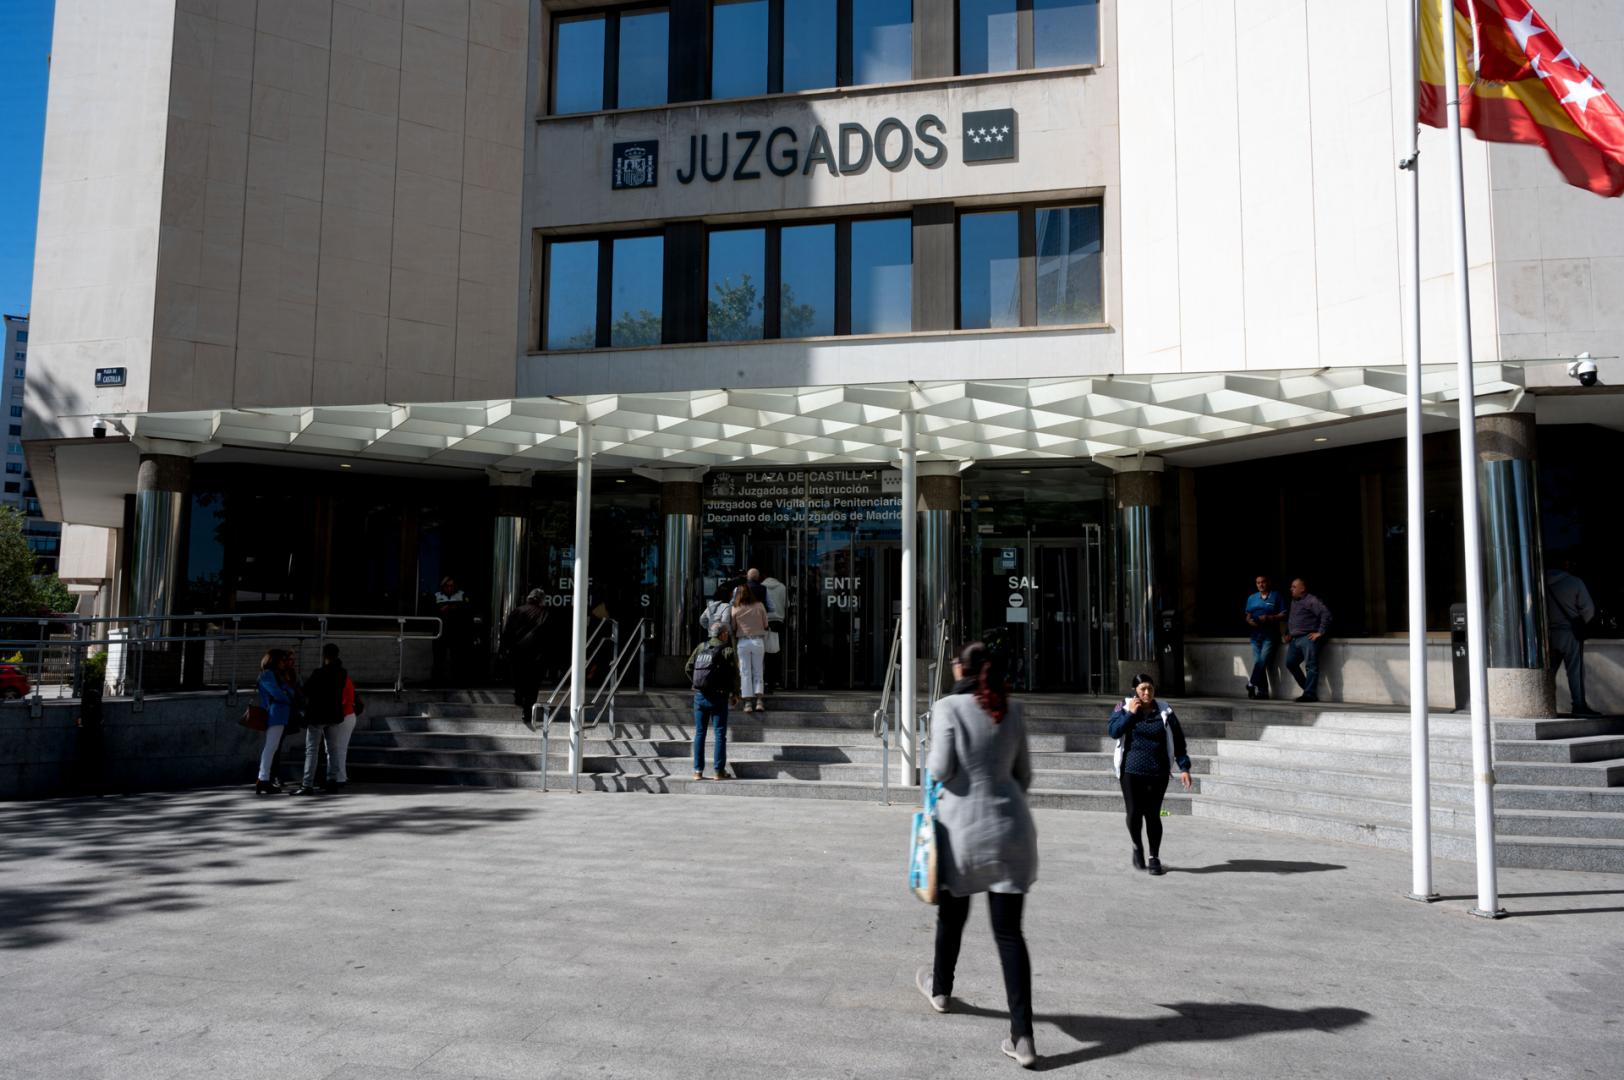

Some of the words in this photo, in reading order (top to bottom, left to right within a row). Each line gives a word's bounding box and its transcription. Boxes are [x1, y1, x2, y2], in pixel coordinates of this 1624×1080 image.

[676, 113, 947, 184] JUZGADOS
[102, 375, 121, 383] CASTILLA
[746, 472, 785, 483] PLAZA
[788, 471, 804, 482] DE
[809, 471, 868, 482] CASTILLA
[738, 485, 789, 498] Juzgados
[791, 485, 804, 495] de
[809, 483, 869, 495] Instrucción
[707, 499, 758, 511] Juzgados
[760, 499, 773, 509] de
[776, 498, 831, 510] Vigilancia
[707, 512, 756, 523] Decanato
[757, 512, 771, 522] de
[773, 511, 790, 522] los
[792, 509, 847, 524] Juzgados
[849, 510, 864, 521] de
[1008, 575, 1039, 590] SAL
